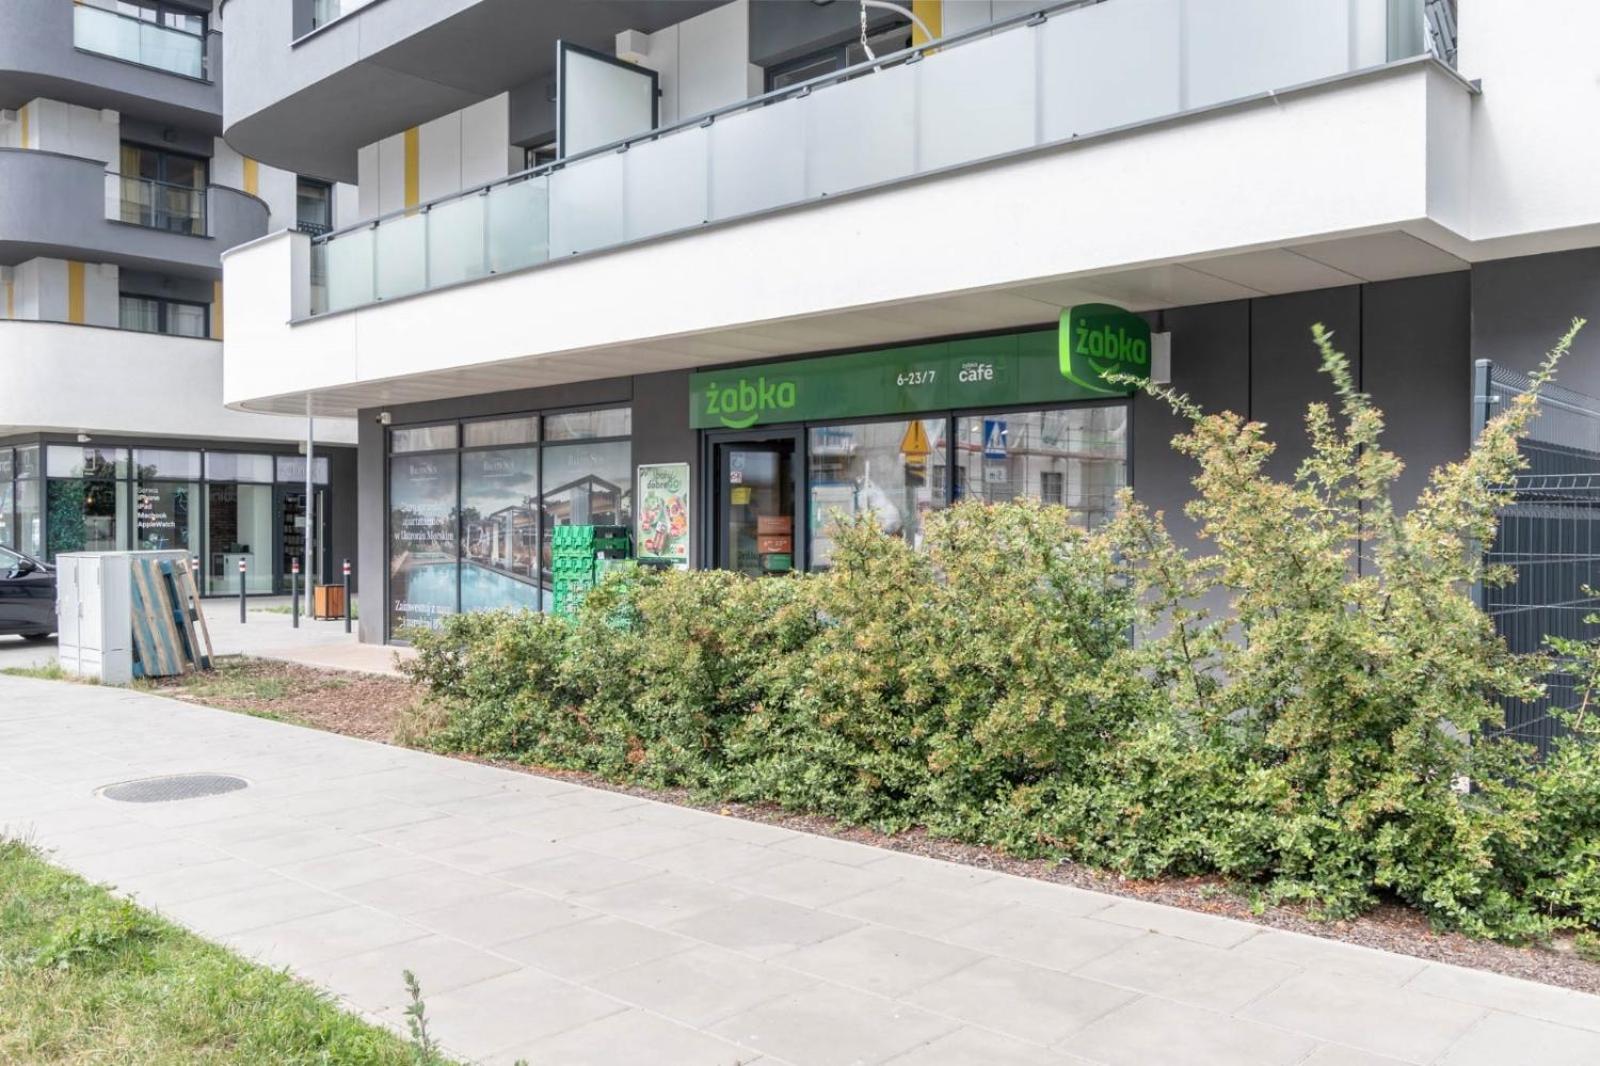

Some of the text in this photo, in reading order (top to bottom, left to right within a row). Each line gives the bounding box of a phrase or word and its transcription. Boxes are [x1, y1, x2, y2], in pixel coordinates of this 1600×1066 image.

[1075, 319, 1147, 365] żabka
[896, 370, 936, 386] 6-23/7
[959, 364, 993, 382] café
[706, 377, 796, 414] żabka
